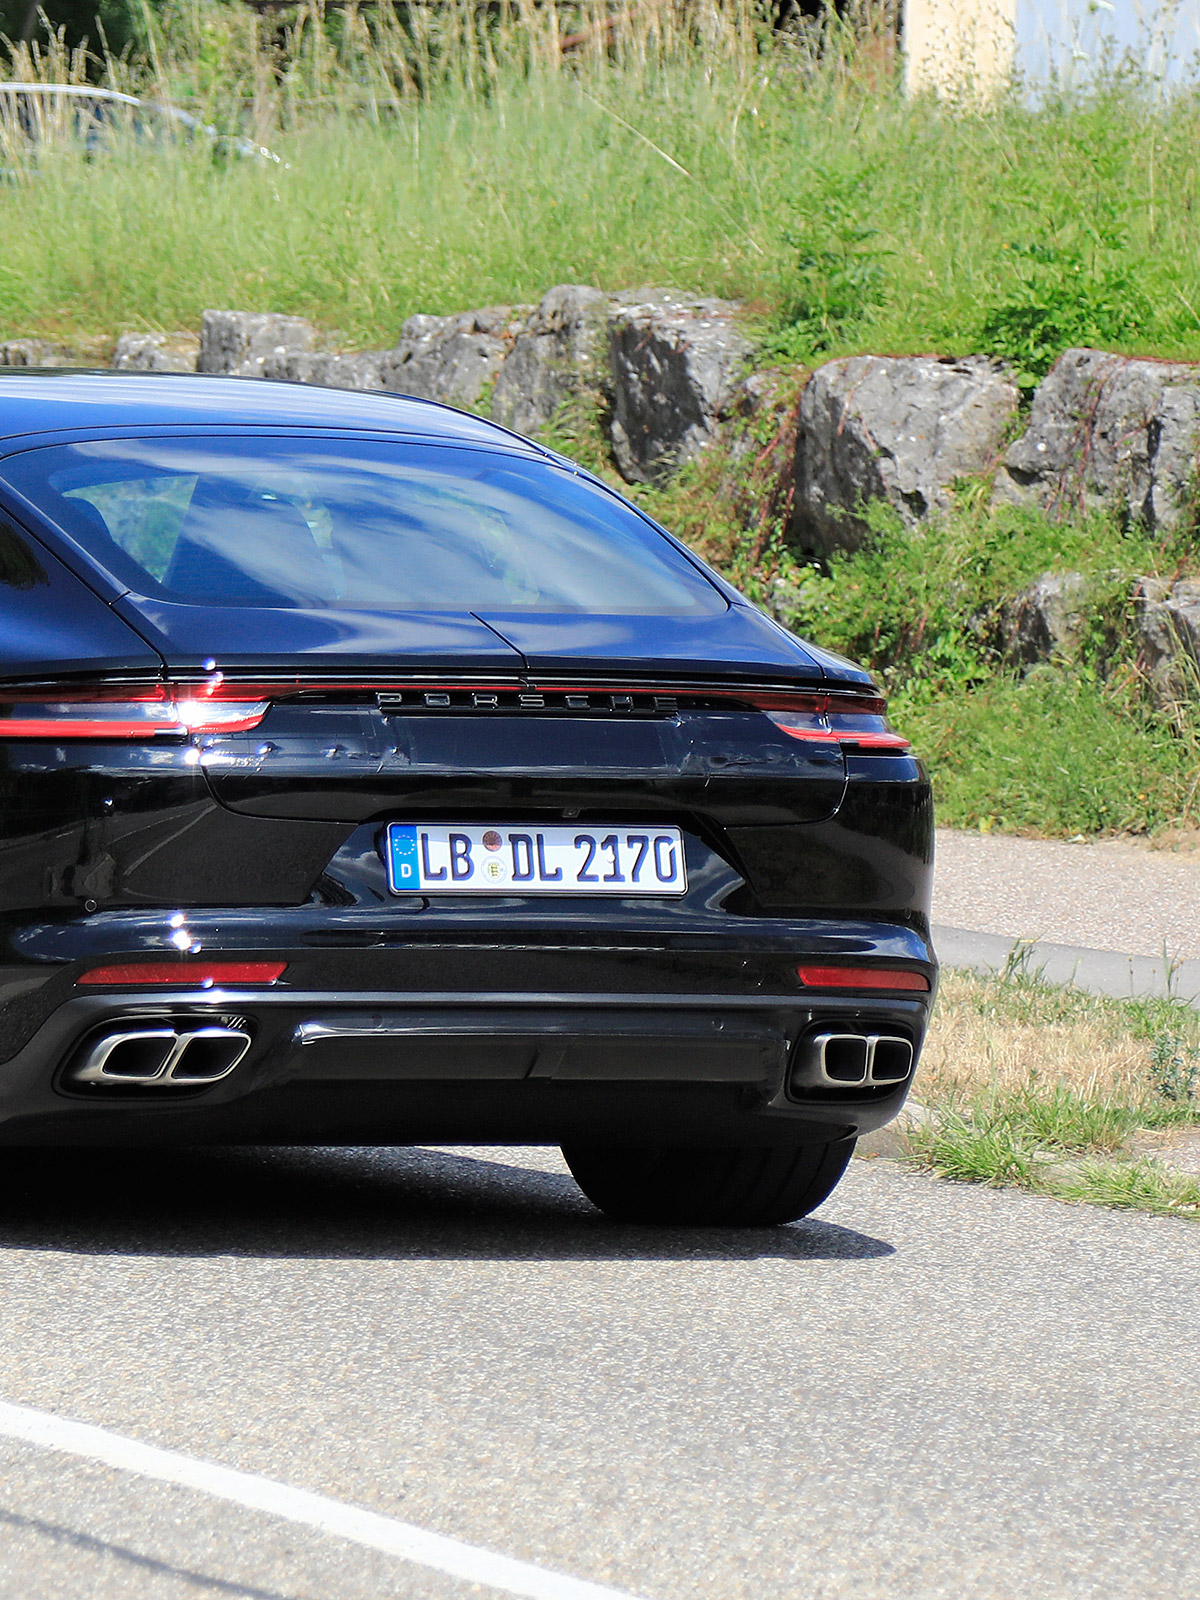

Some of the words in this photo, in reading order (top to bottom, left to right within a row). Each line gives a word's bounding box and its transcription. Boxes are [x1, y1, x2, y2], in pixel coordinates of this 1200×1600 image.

[376, 692, 678, 711] PORSCHE
[421, 833, 474, 881] LB
[508, 833, 563, 882] DL
[574, 834, 678, 883] 2170
[400, 864, 412, 878] D
